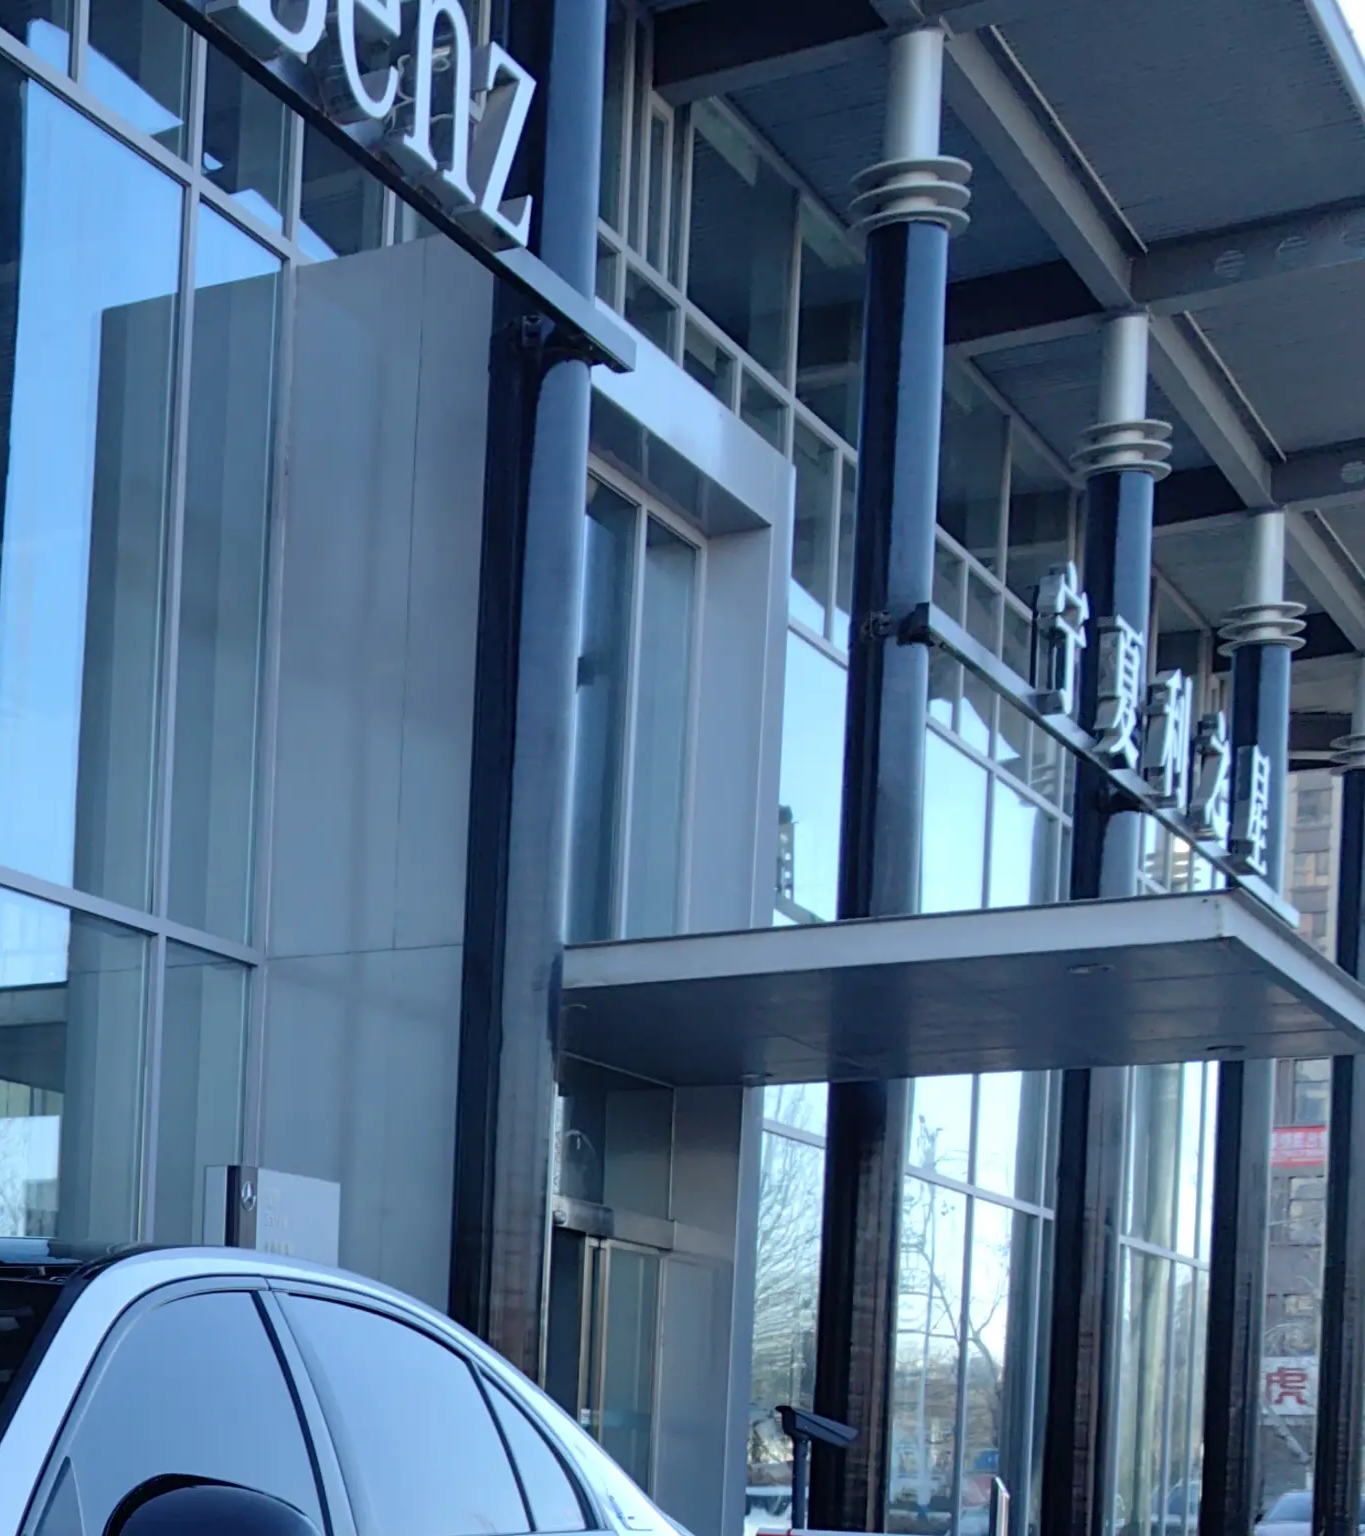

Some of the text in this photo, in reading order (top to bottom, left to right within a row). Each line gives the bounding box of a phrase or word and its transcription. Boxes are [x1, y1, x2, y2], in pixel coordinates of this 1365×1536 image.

[236, 0, 537, 247] enz
[1055, 561, 1270, 875] 宁夏利之星
